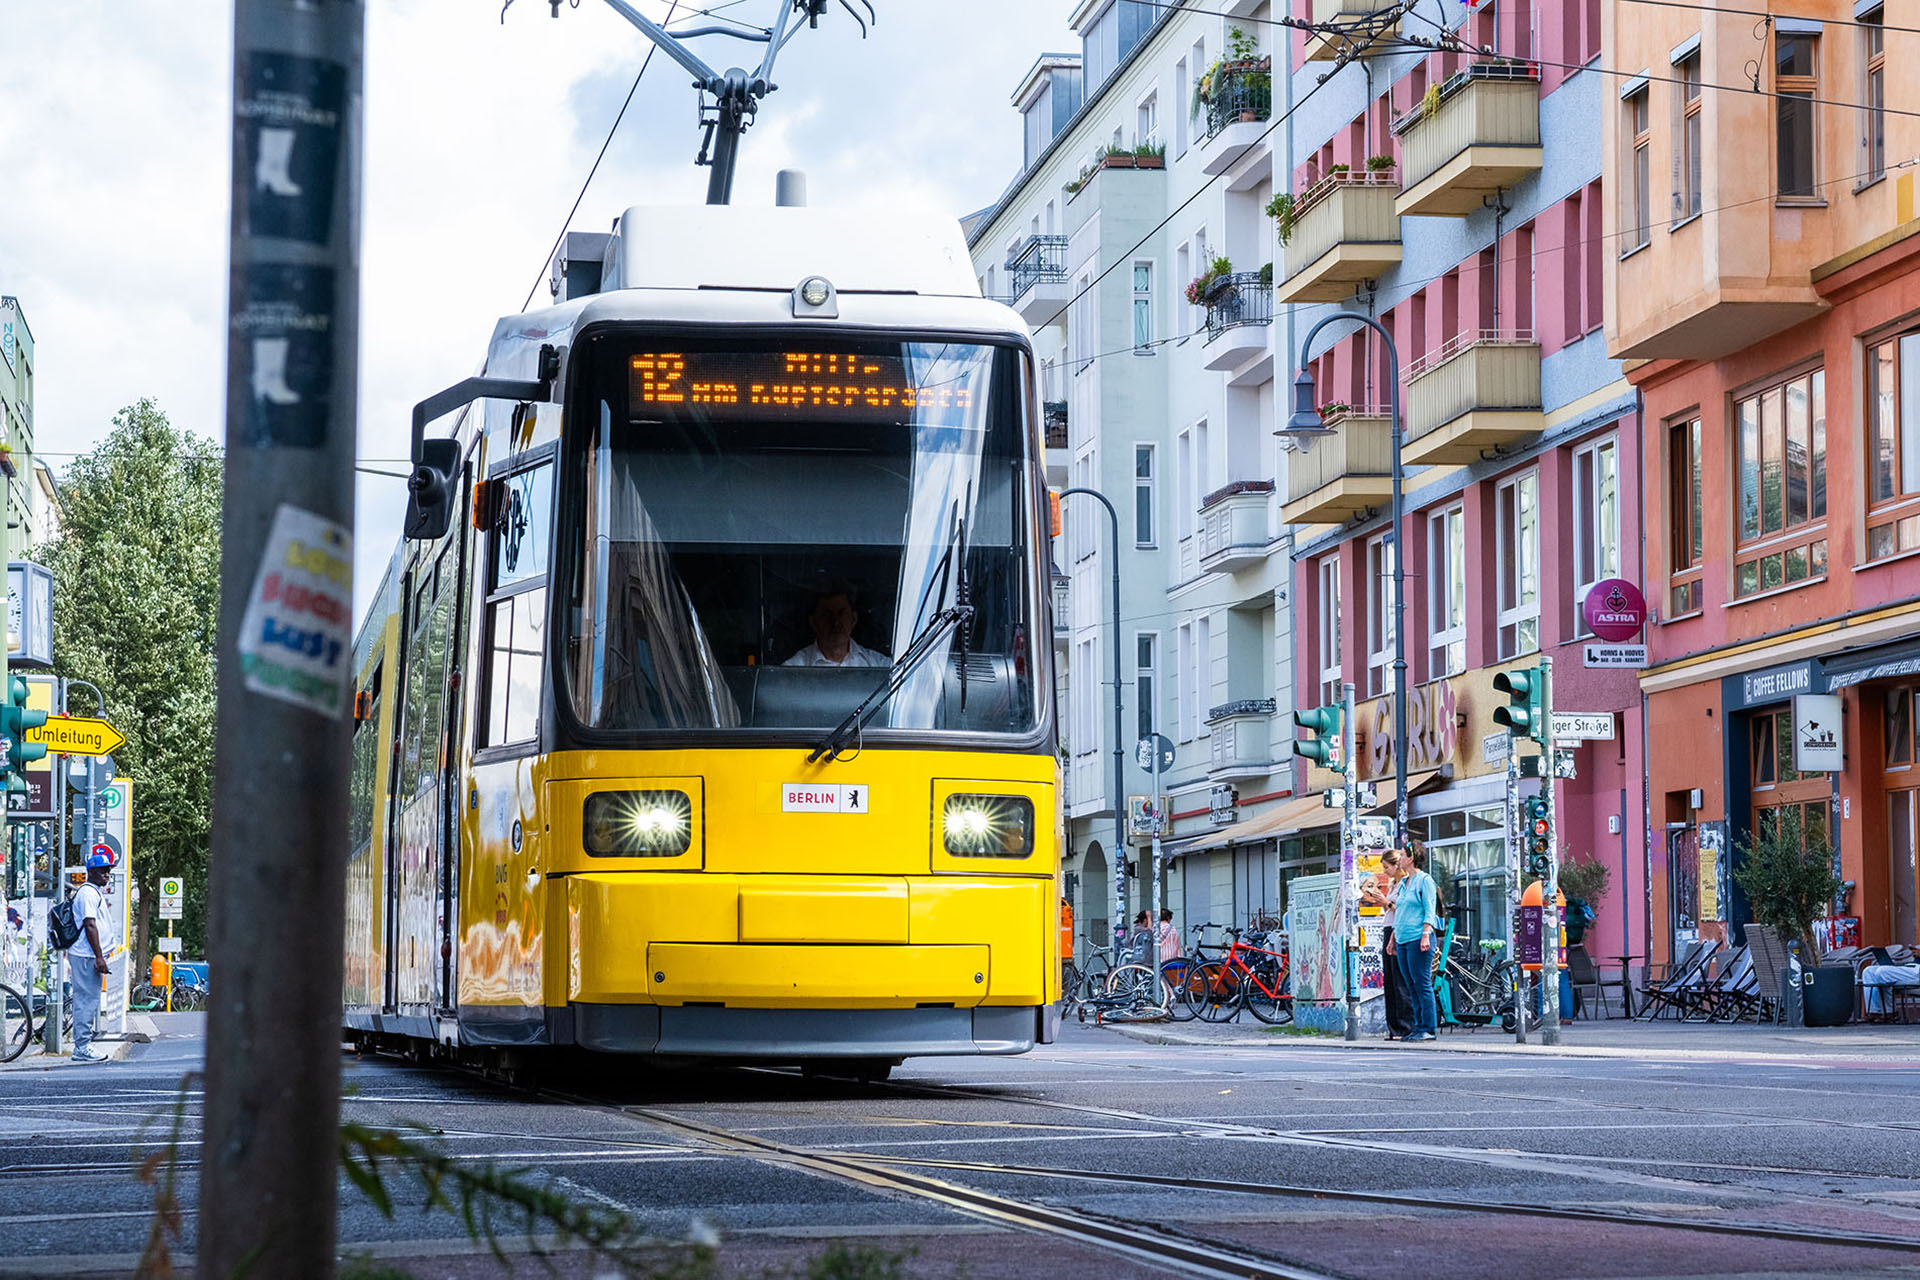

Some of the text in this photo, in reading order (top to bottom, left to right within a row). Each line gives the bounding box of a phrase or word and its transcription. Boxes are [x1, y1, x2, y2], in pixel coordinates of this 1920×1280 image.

[1597, 613, 1636, 622] ASTRA
[1753, 668, 1809, 697] COFFEE FELLOWS
[1552, 720, 1571, 733] iger
[33, 727, 102, 749] Umleitung
[788, 792, 835, 804] BERLIN
